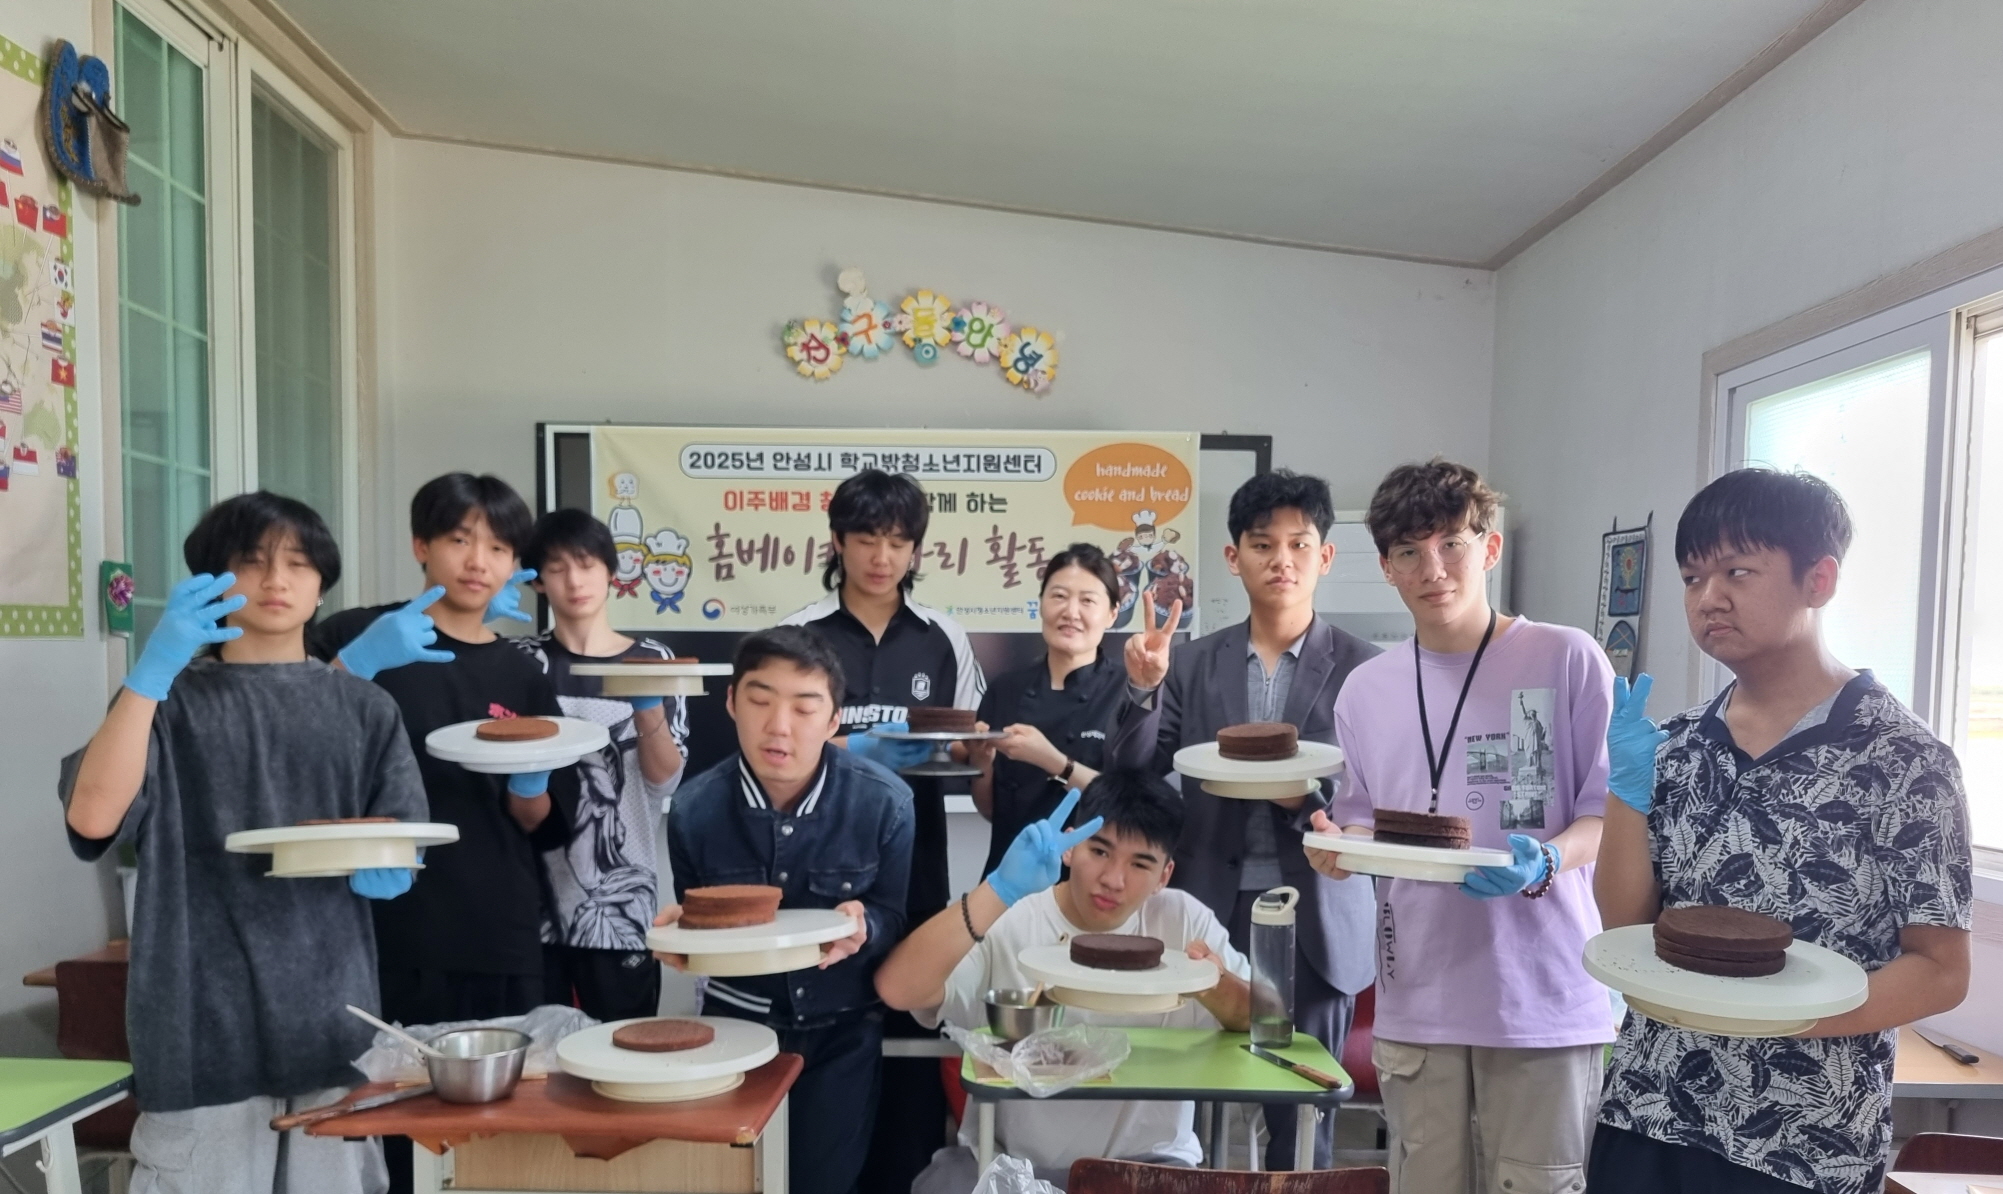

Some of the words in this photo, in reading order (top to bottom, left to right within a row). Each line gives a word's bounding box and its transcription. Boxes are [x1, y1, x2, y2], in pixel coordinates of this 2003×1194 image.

[688, 451, 765, 471] 2025년
[772, 451, 832, 472] 안성시
[840, 452, 1042, 474] 학교밖청소년지원센터
[1095, 462, 1168, 478] handmade
[723, 489, 812, 512] 이주배경
[965, 491, 1009, 514] 하는
[1074, 486, 1115, 502] cookie
[1118, 487, 1145, 502] and
[1149, 486, 1190, 503] bread
[984, 524, 1050, 589] 활동
